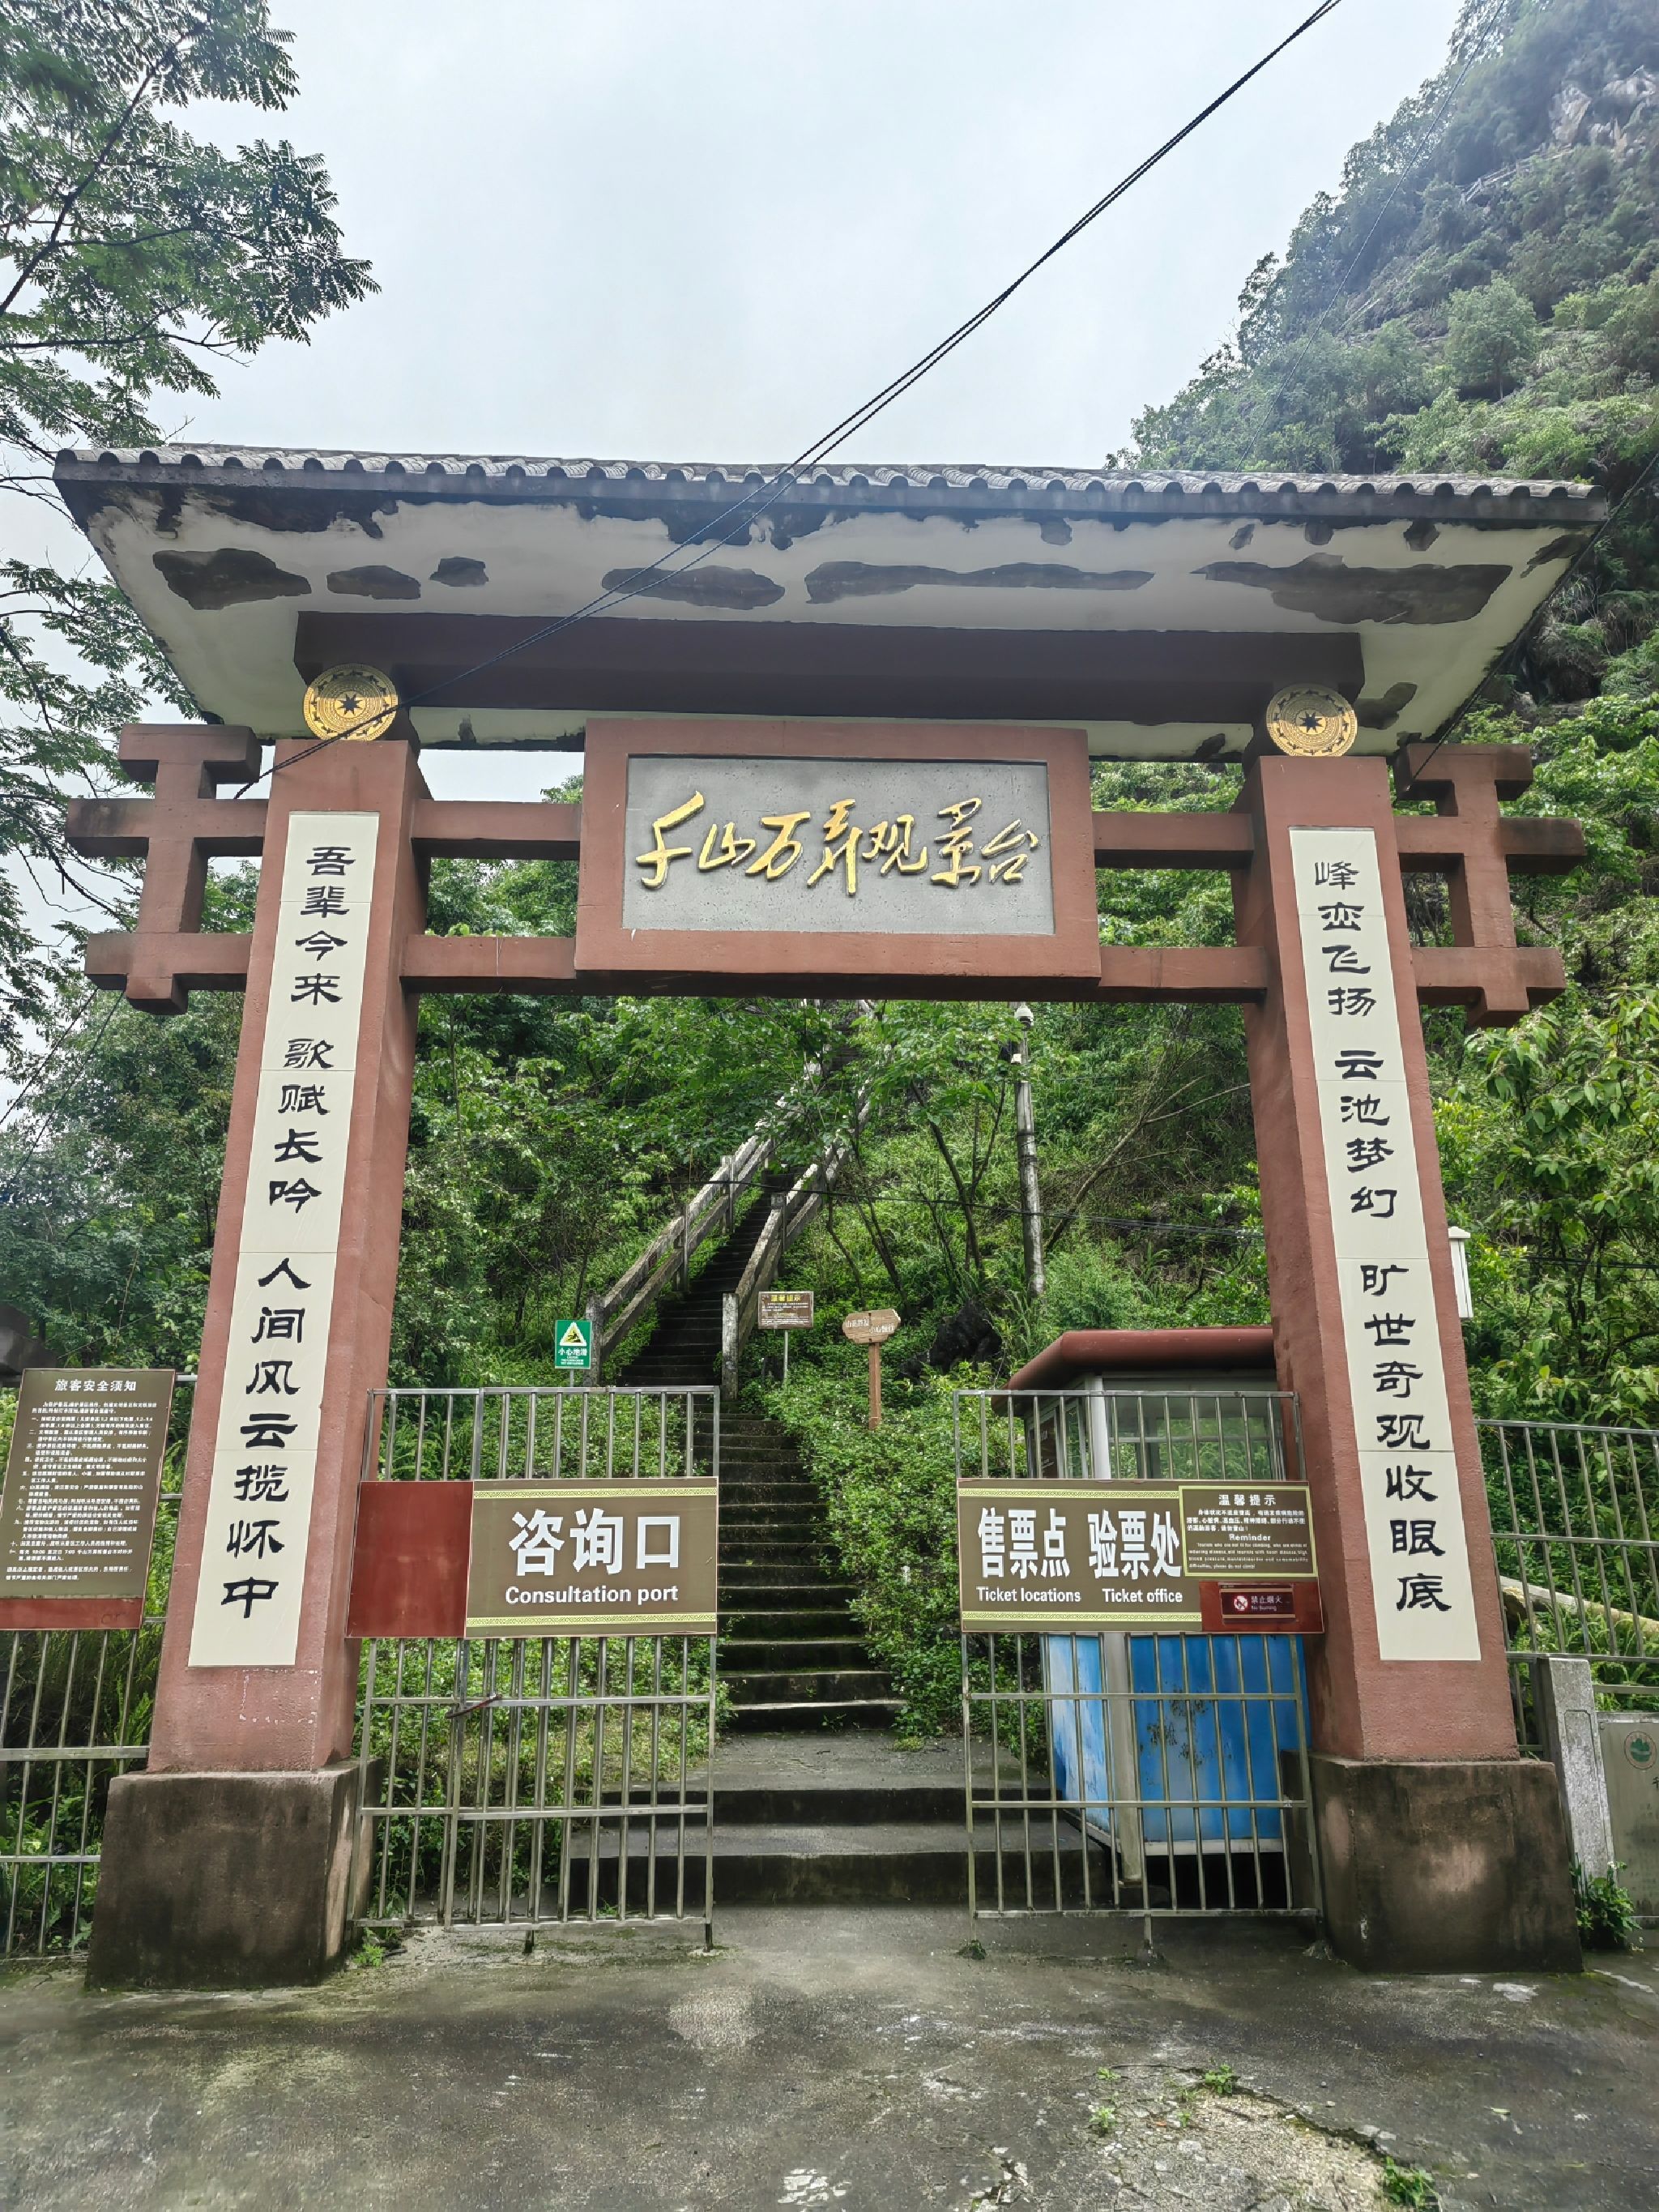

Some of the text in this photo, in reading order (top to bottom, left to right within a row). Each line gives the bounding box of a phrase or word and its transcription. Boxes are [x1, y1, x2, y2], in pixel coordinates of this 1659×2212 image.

[220, 846, 356, 1620] 吾辈今来 歌赋长吟 人间风云揽怀中
[1314, 860, 1452, 1612] 峰峦飞扬 云池梦幻 旷世奇观收眼底
[558, 1347, 588, 1356] 小心地滑
[54, 1379, 137, 1392] 旅客安全须知
[1218, 1494, 1277, 1506] 温馨提示
[508, 1508, 680, 1577] 咨询口
[978, 1507, 1182, 1580] 售票点 验票处
[1229, 1533, 1271, 1541] Reminder
[505, 1585, 679, 1605] Consultation port
[976, 1586, 1081, 1603] Ticket locations
[1102, 1588, 1183, 1603] Ticket office
